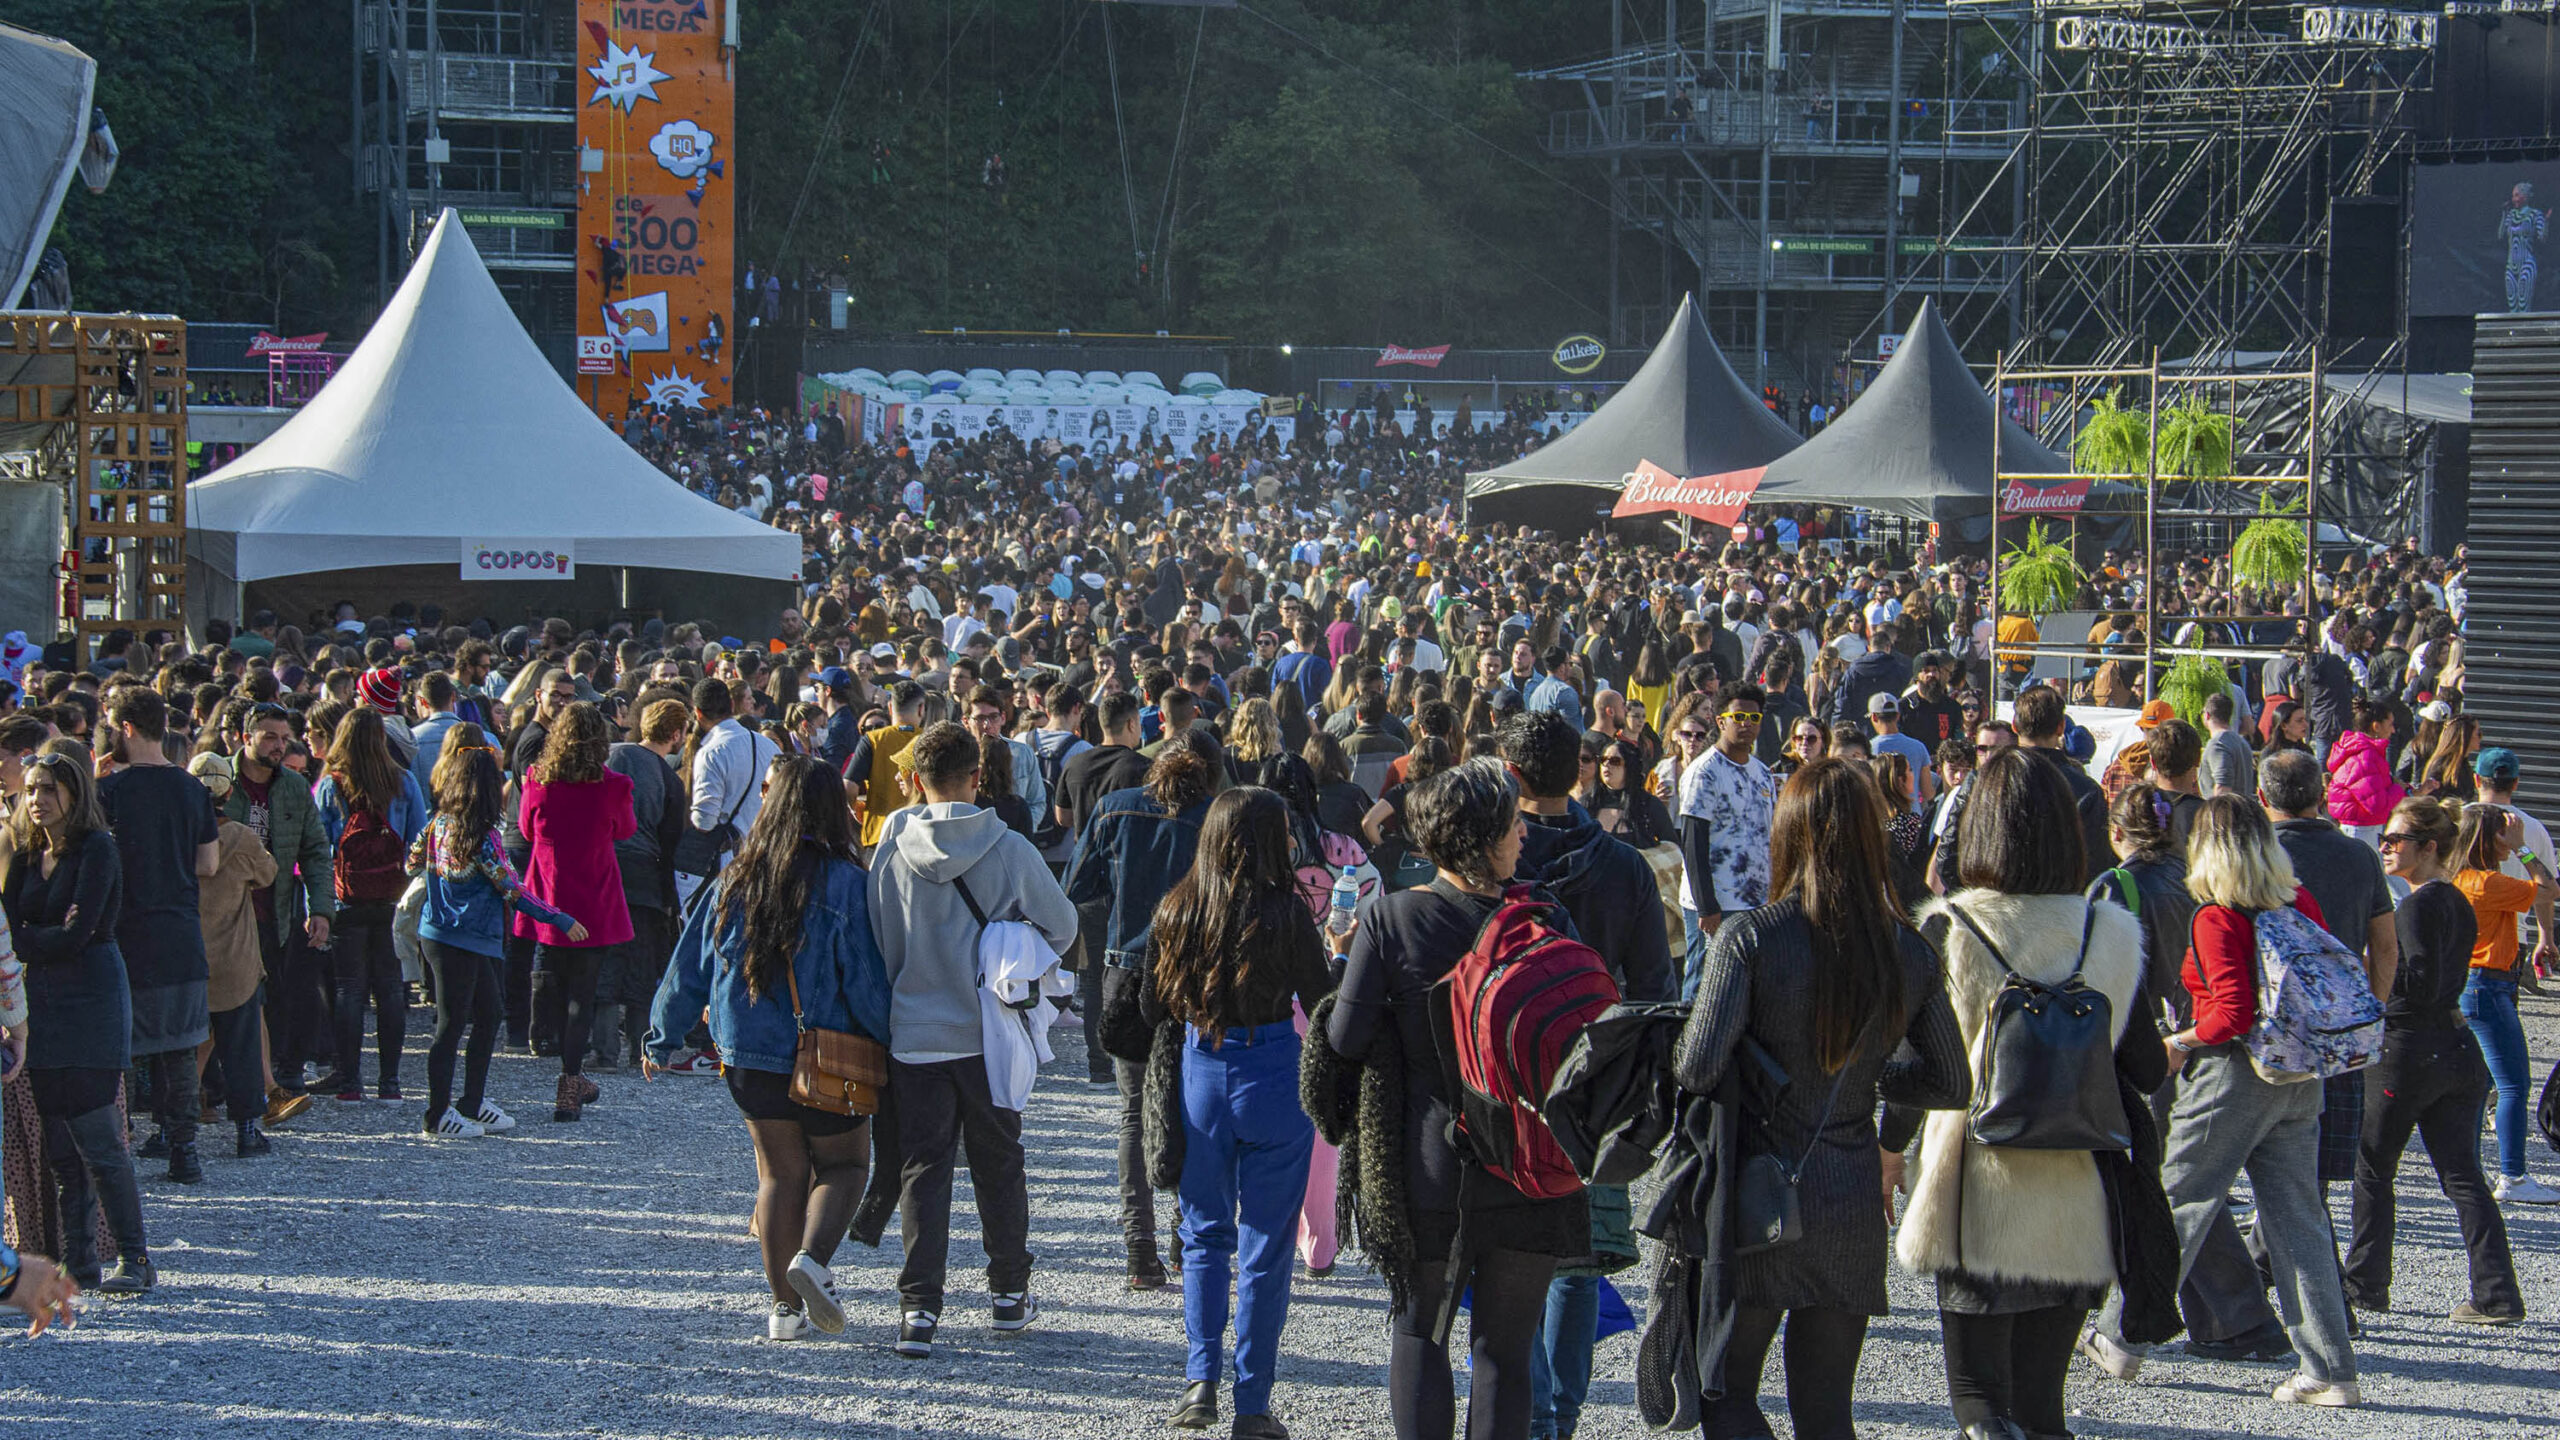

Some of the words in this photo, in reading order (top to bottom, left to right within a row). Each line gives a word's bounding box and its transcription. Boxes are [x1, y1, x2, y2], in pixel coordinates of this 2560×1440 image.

[614, 7, 698, 33] MEGA
[672, 138, 693, 155] HQ
[615, 195, 643, 212] de
[615, 215, 698, 251] 300
[617, 254, 697, 276] MEGA
[250, 335, 321, 351] Budweiser
[1557, 343, 1601, 362] mike's
[1379, 346, 1445, 362] Budweiser
[1622, 472, 1752, 507] Budweiser
[2000, 487, 2086, 511] Budweiser
[476, 550, 556, 570] COPOS
